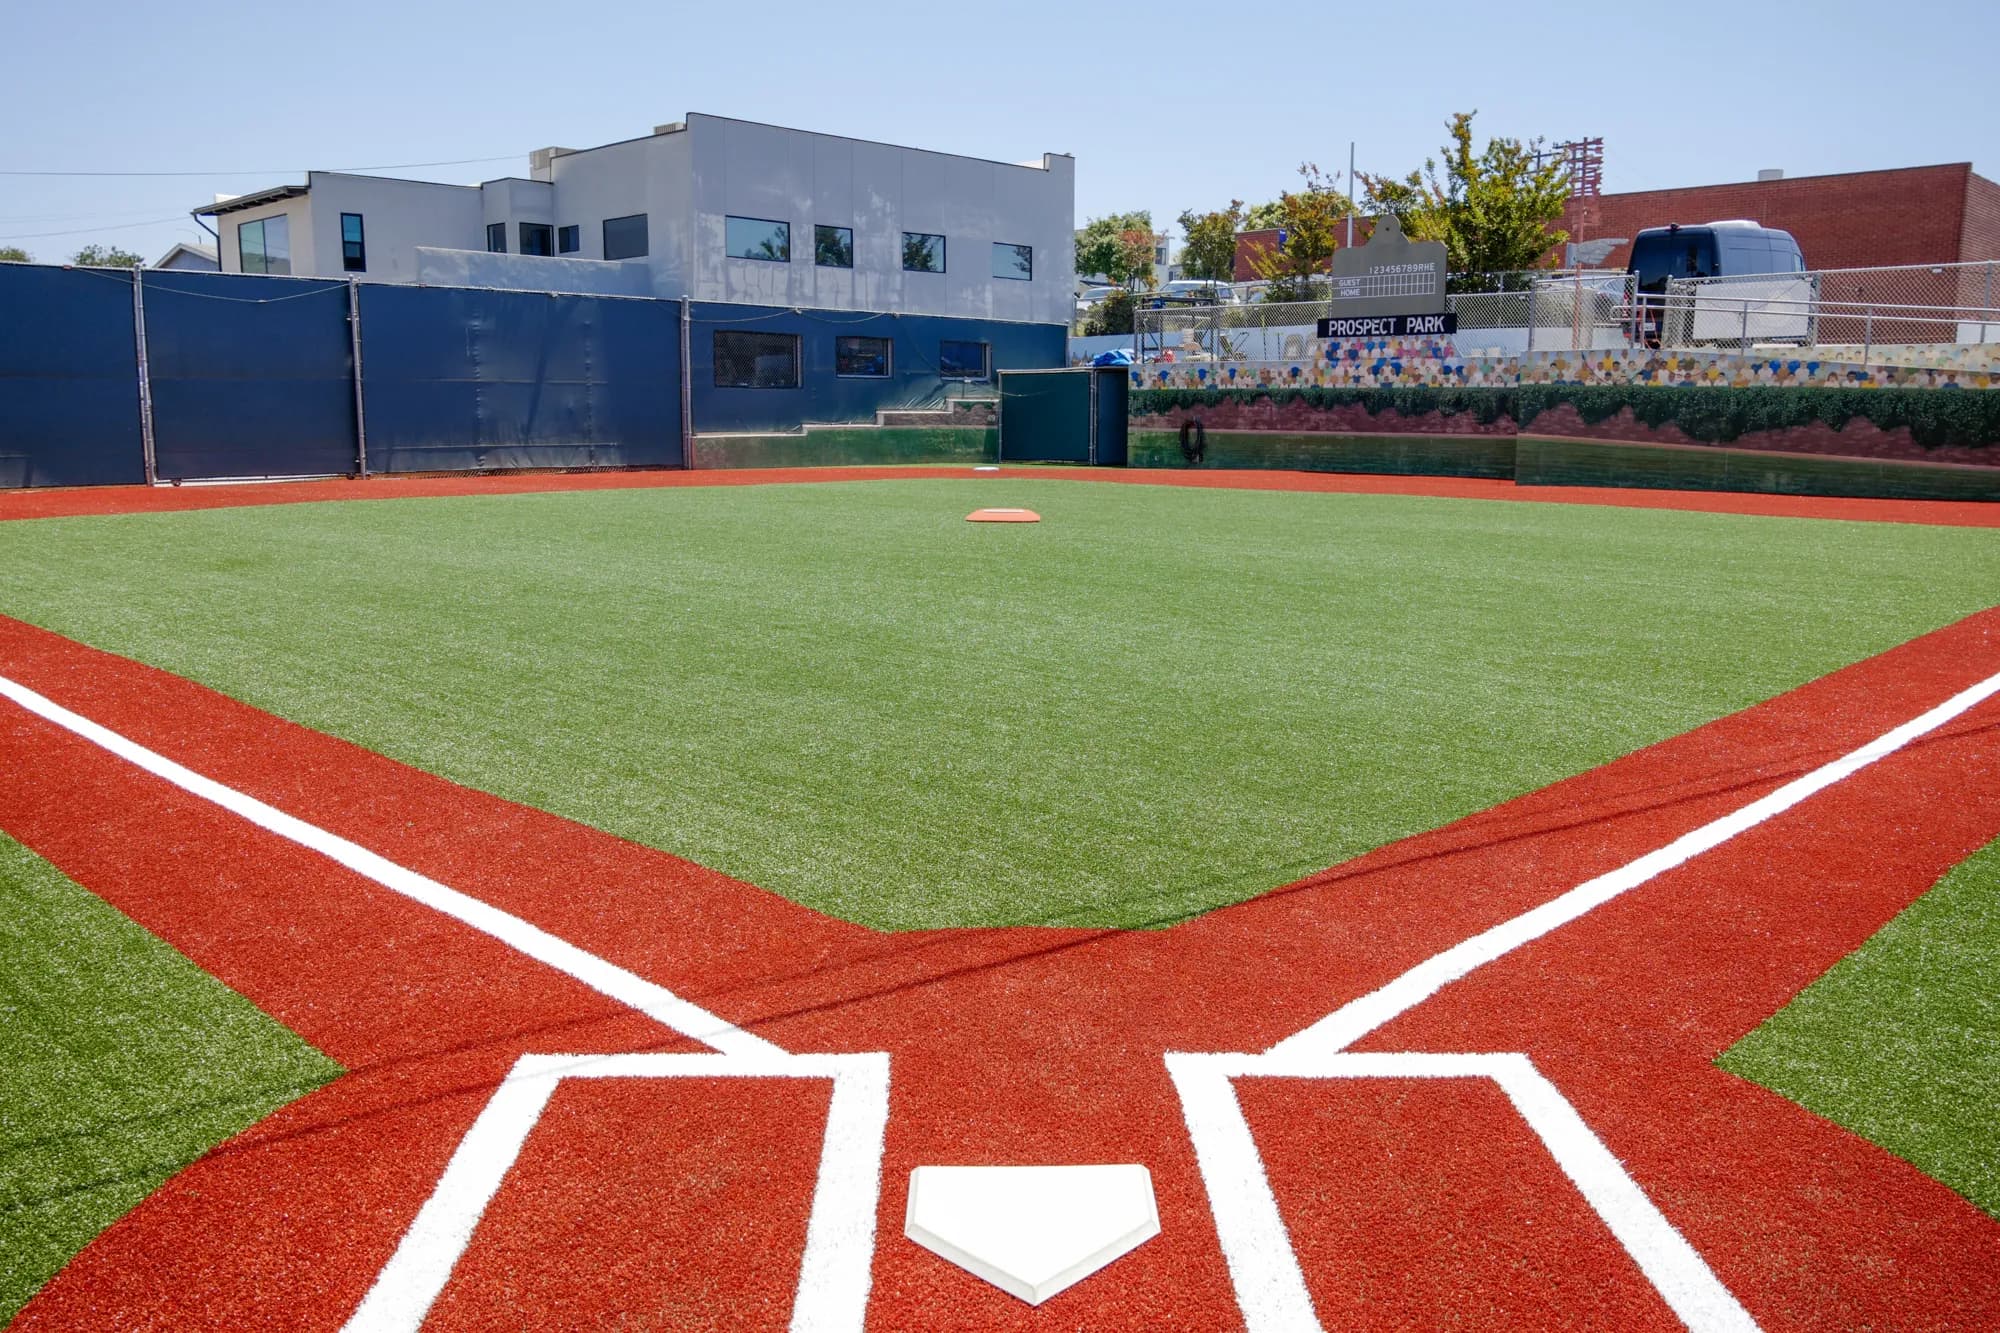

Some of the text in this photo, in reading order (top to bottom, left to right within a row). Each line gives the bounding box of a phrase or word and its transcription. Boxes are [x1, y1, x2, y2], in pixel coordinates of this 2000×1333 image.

[1338, 279, 1361, 287] GUEST
[1328, 316, 1445, 336] PROSPECT PARK
